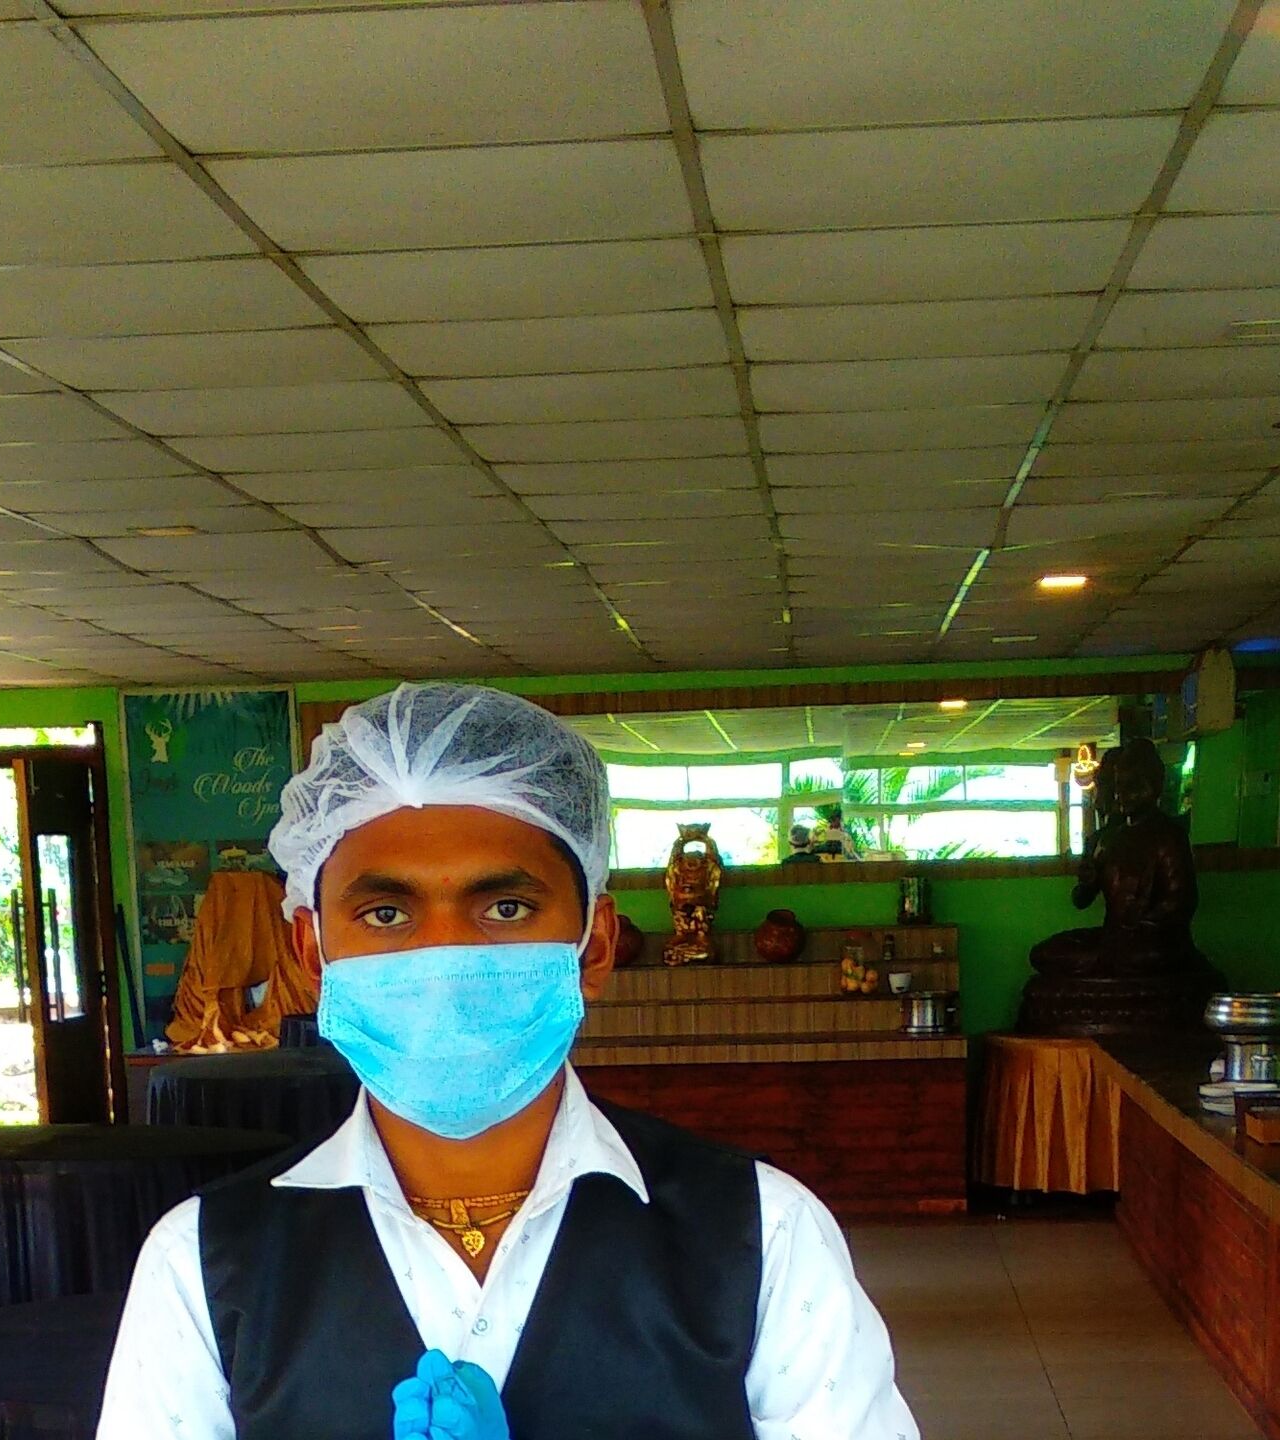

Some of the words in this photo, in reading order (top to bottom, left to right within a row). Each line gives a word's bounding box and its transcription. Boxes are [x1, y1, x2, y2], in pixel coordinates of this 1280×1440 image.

[233, 744, 275, 772] The
[193, 767, 278, 802] Woods
[237, 797, 280, 826] Spa
